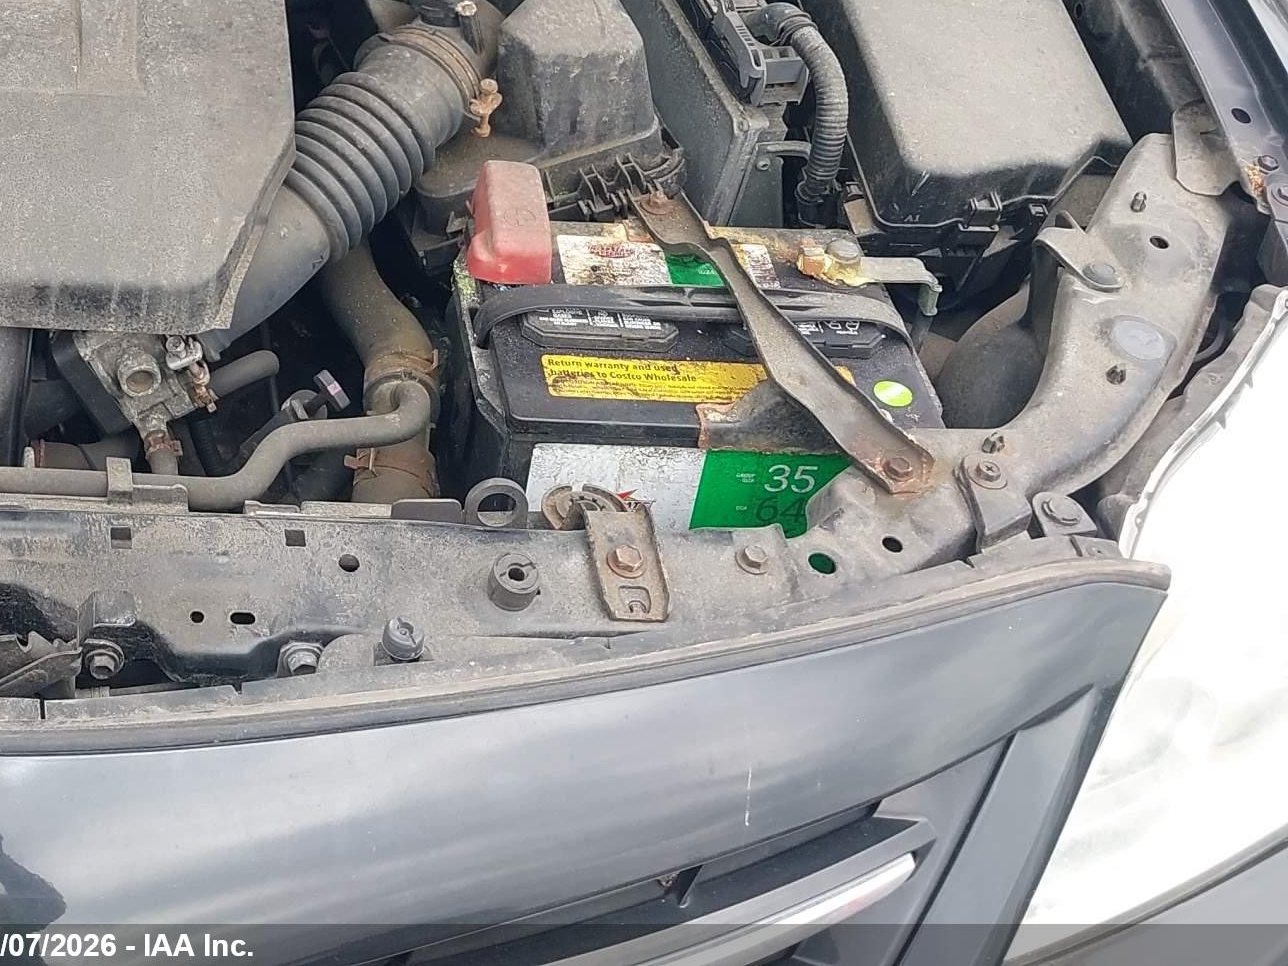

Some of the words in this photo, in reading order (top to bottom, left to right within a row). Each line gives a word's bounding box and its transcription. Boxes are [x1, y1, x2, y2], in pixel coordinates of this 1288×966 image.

[547, 358, 583, 368] Return
[585, 361, 629, 372] warranty
[632, 362, 651, 371] and
[653, 363, 677, 373] used
[597, 371, 607, 379] to
[610, 371, 642, 381] Costco
[643, 372, 697, 382] Wholesale
[764, 464, 819, 494] 35
